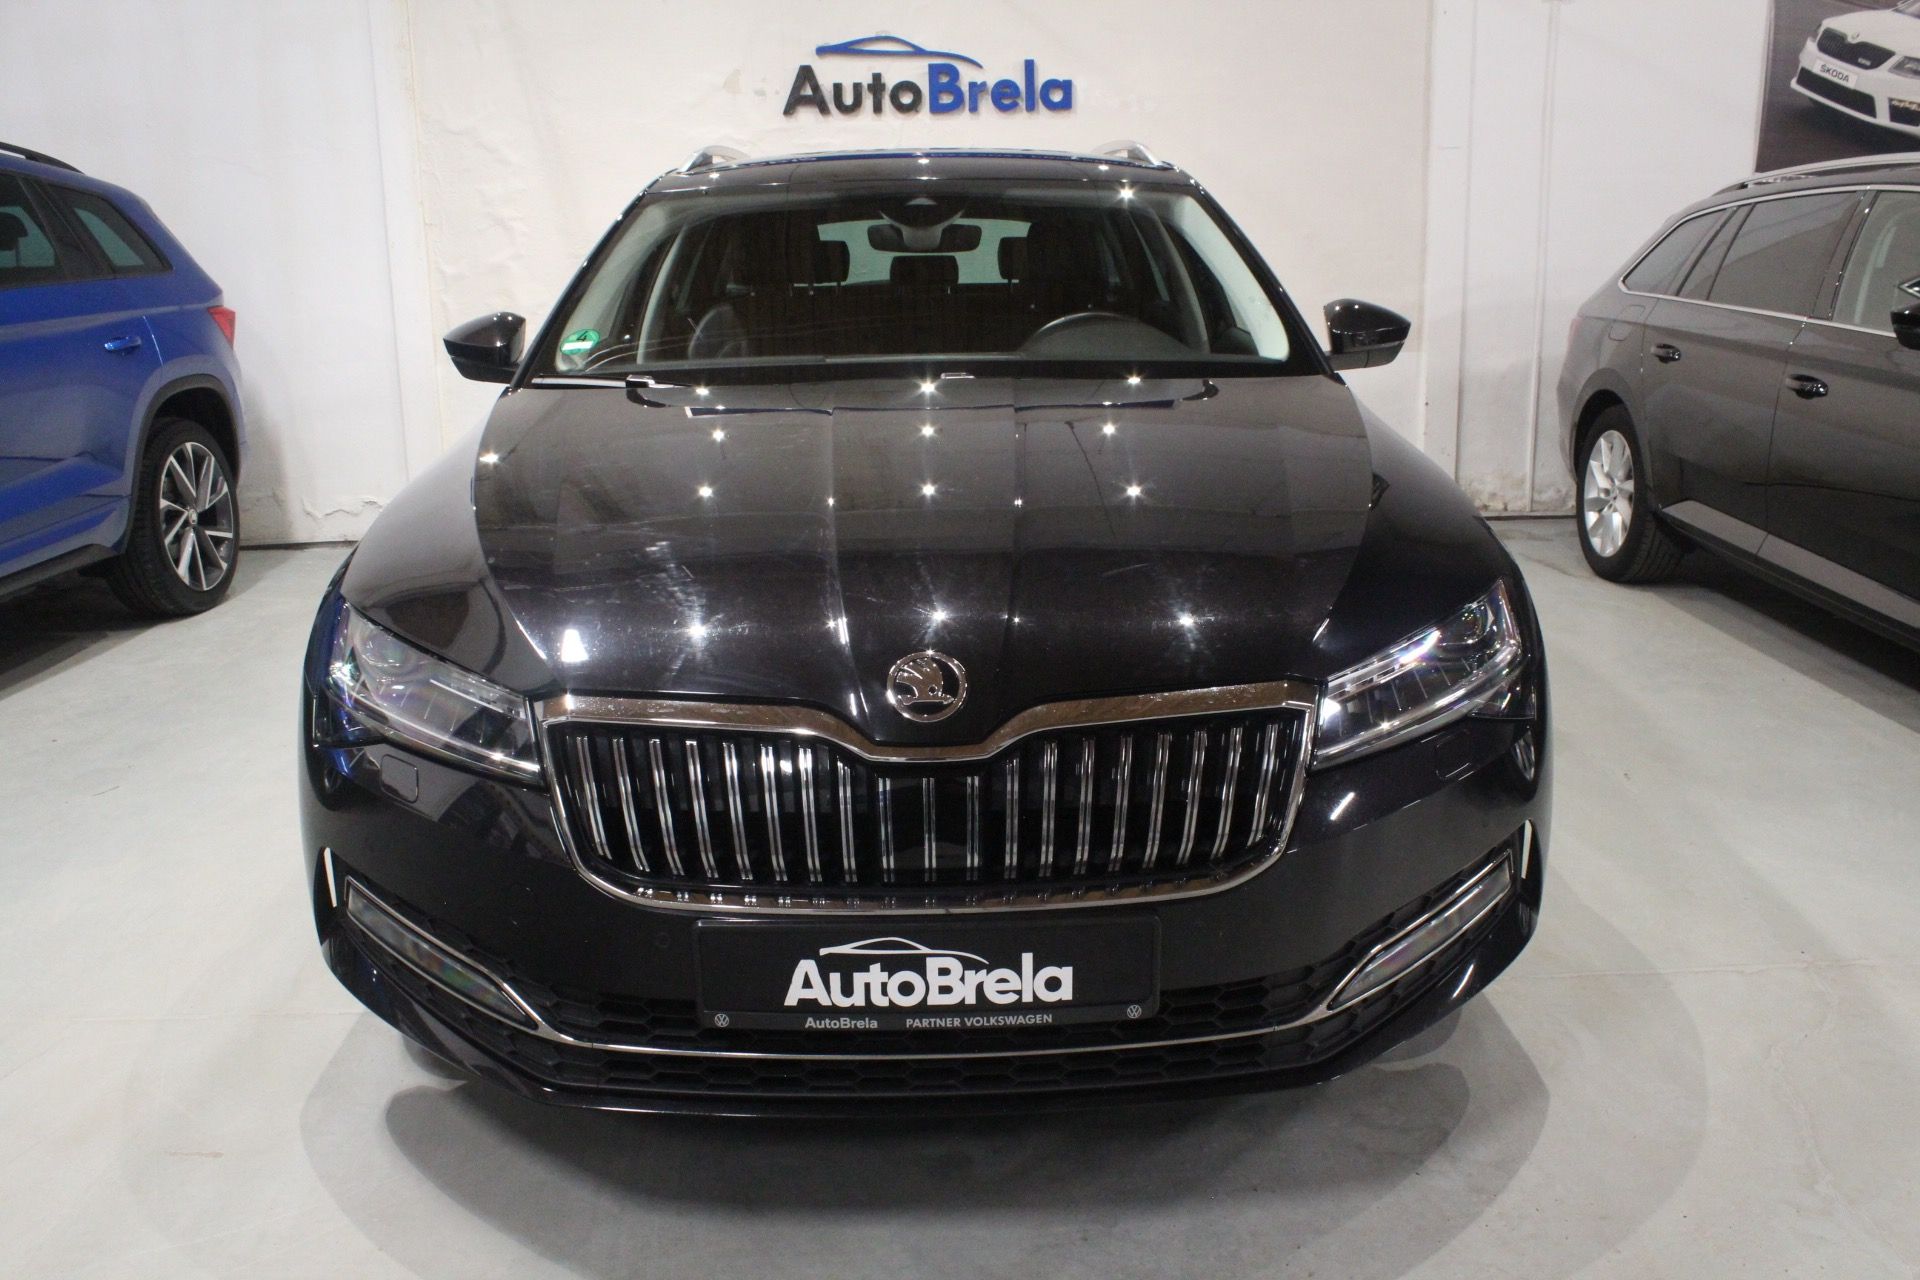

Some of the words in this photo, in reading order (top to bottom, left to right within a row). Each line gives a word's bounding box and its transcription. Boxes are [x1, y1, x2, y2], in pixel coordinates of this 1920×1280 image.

[782, 58, 1073, 116] AutoBrela
[576, 330, 588, 342] 4
[783, 952, 1073, 1008] AutoBrela
[804, 1017, 879, 1029] AutoBrela
[906, 1017, 961, 1028] PARTNER
[964, 1013, 1053, 1028] VOLKSWAGEN
